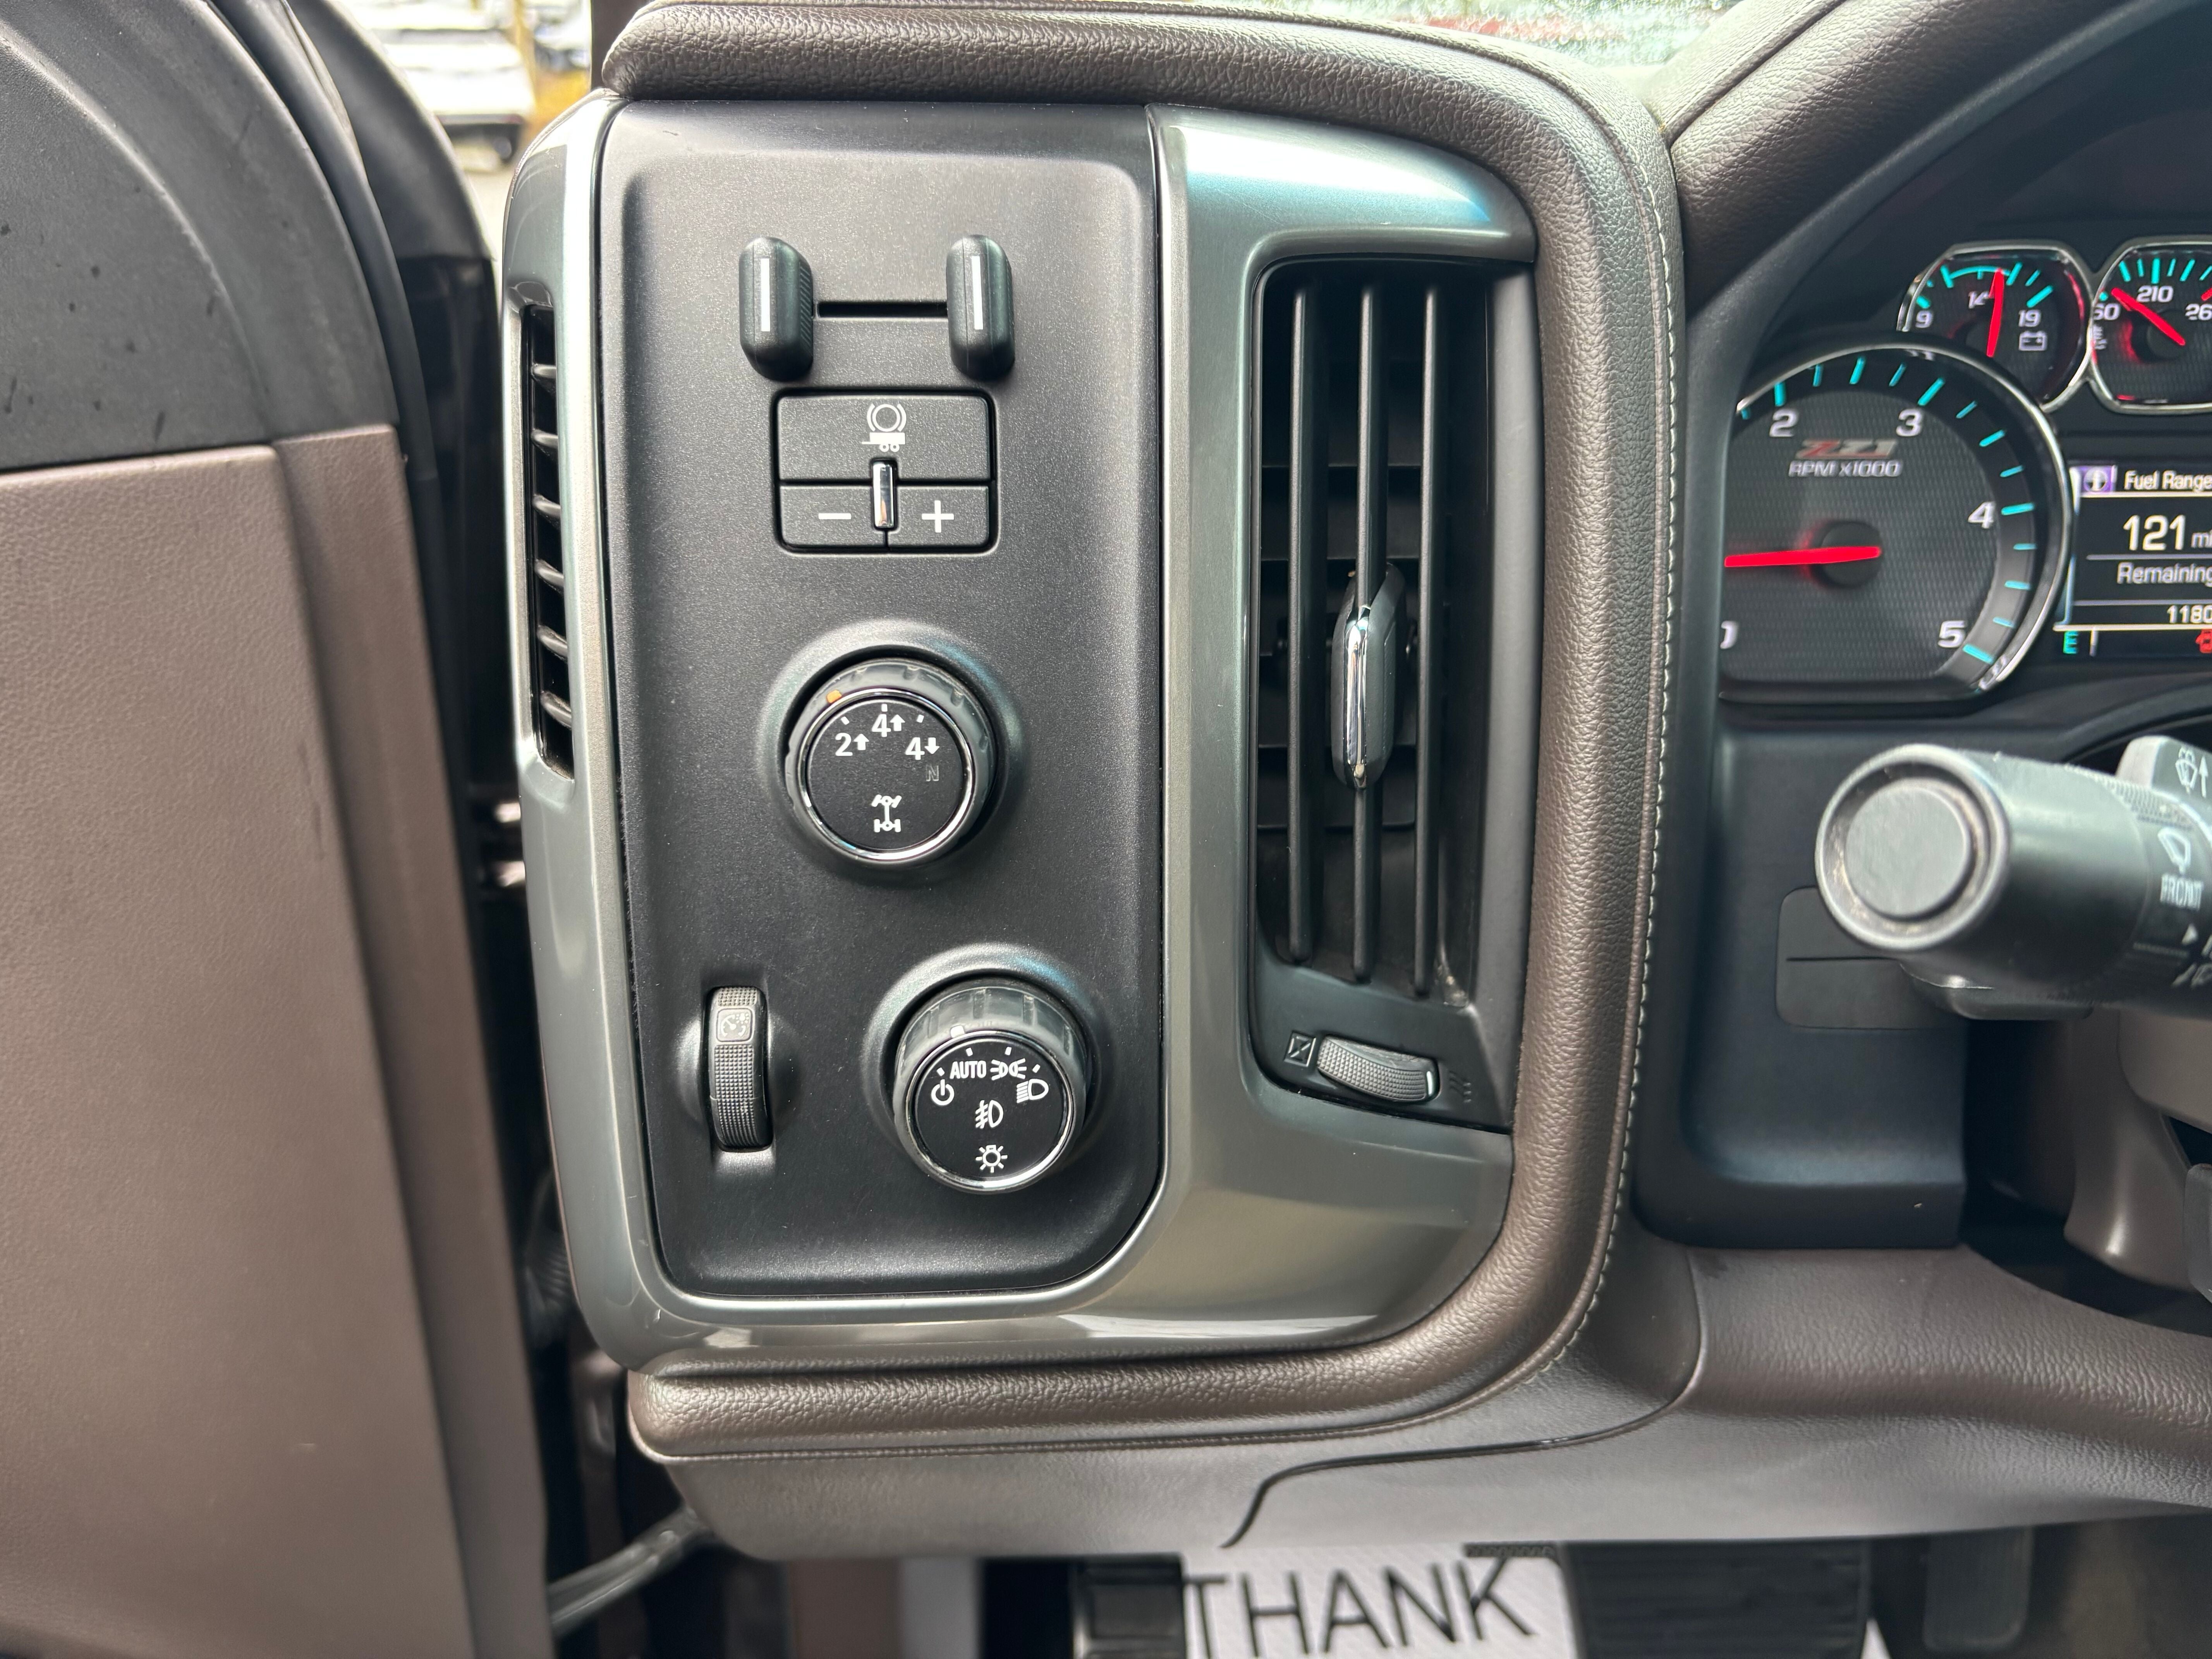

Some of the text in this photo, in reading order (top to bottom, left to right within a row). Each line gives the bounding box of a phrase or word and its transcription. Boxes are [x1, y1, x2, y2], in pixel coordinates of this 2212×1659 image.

[2136, 285, 2174, 302] 210
[1915, 310, 1933, 328] 9
[2018, 309, 2041, 327] 19
[1769, 408, 1798, 437] 2
[1896, 408, 1924, 437] 3
[1788, 460, 1837, 477] RPM
[2124, 470, 2212, 493] Fuel Range
[1968, 501, 1995, 529] 4
[2123, 514, 2185, 551] 121
[1938, 620, 1966, 647] 5
[2063, 630, 2079, 654] E
[872, 714, 891, 737] 4
[835, 733, 853, 756] 2
[905, 737, 925, 760] 4
[926, 764, 939, 781] N
[950, 1060, 987, 1079] AUTO
[1183, 1559, 1535, 1659] THANK
